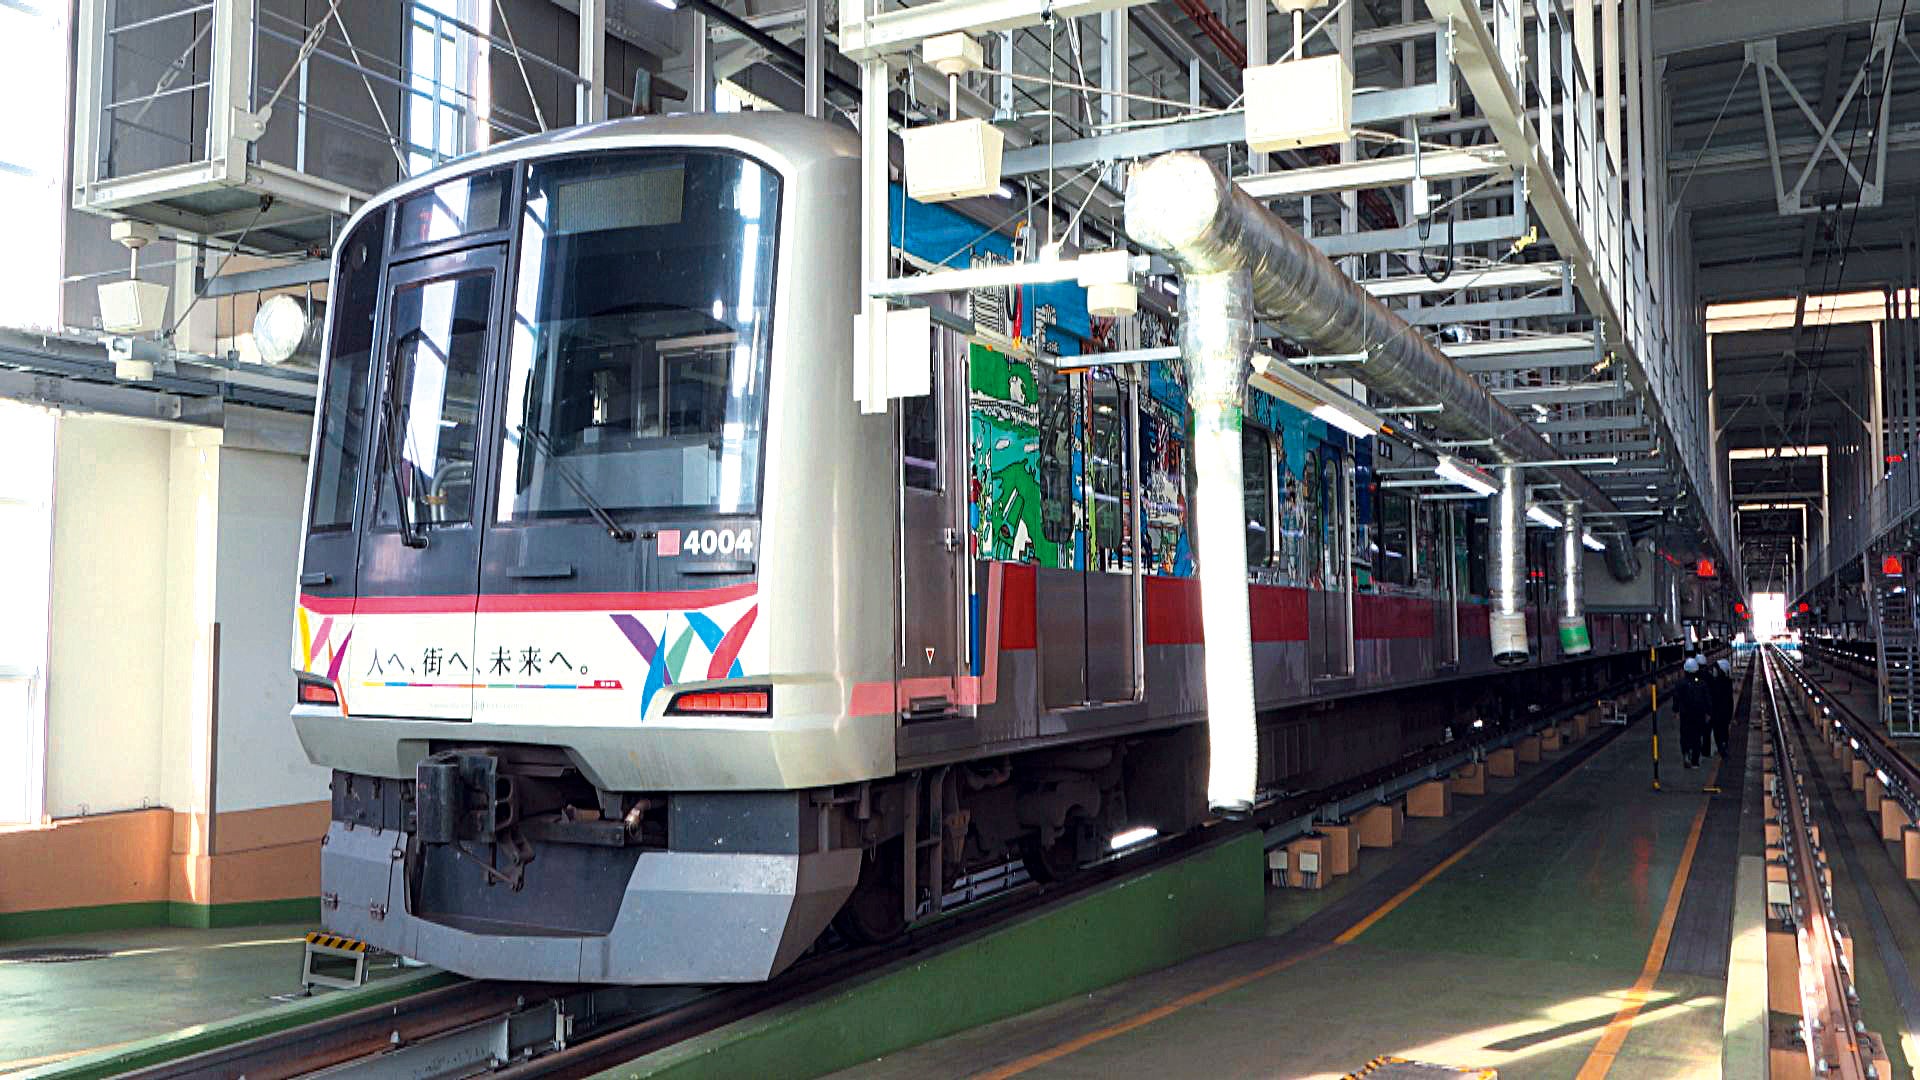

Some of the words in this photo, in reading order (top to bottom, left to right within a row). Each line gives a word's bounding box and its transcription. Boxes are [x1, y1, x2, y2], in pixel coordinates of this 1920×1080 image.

[683, 529, 753, 555] 4004
[366, 645, 589, 677] 人へ、街へ、未来へ。
